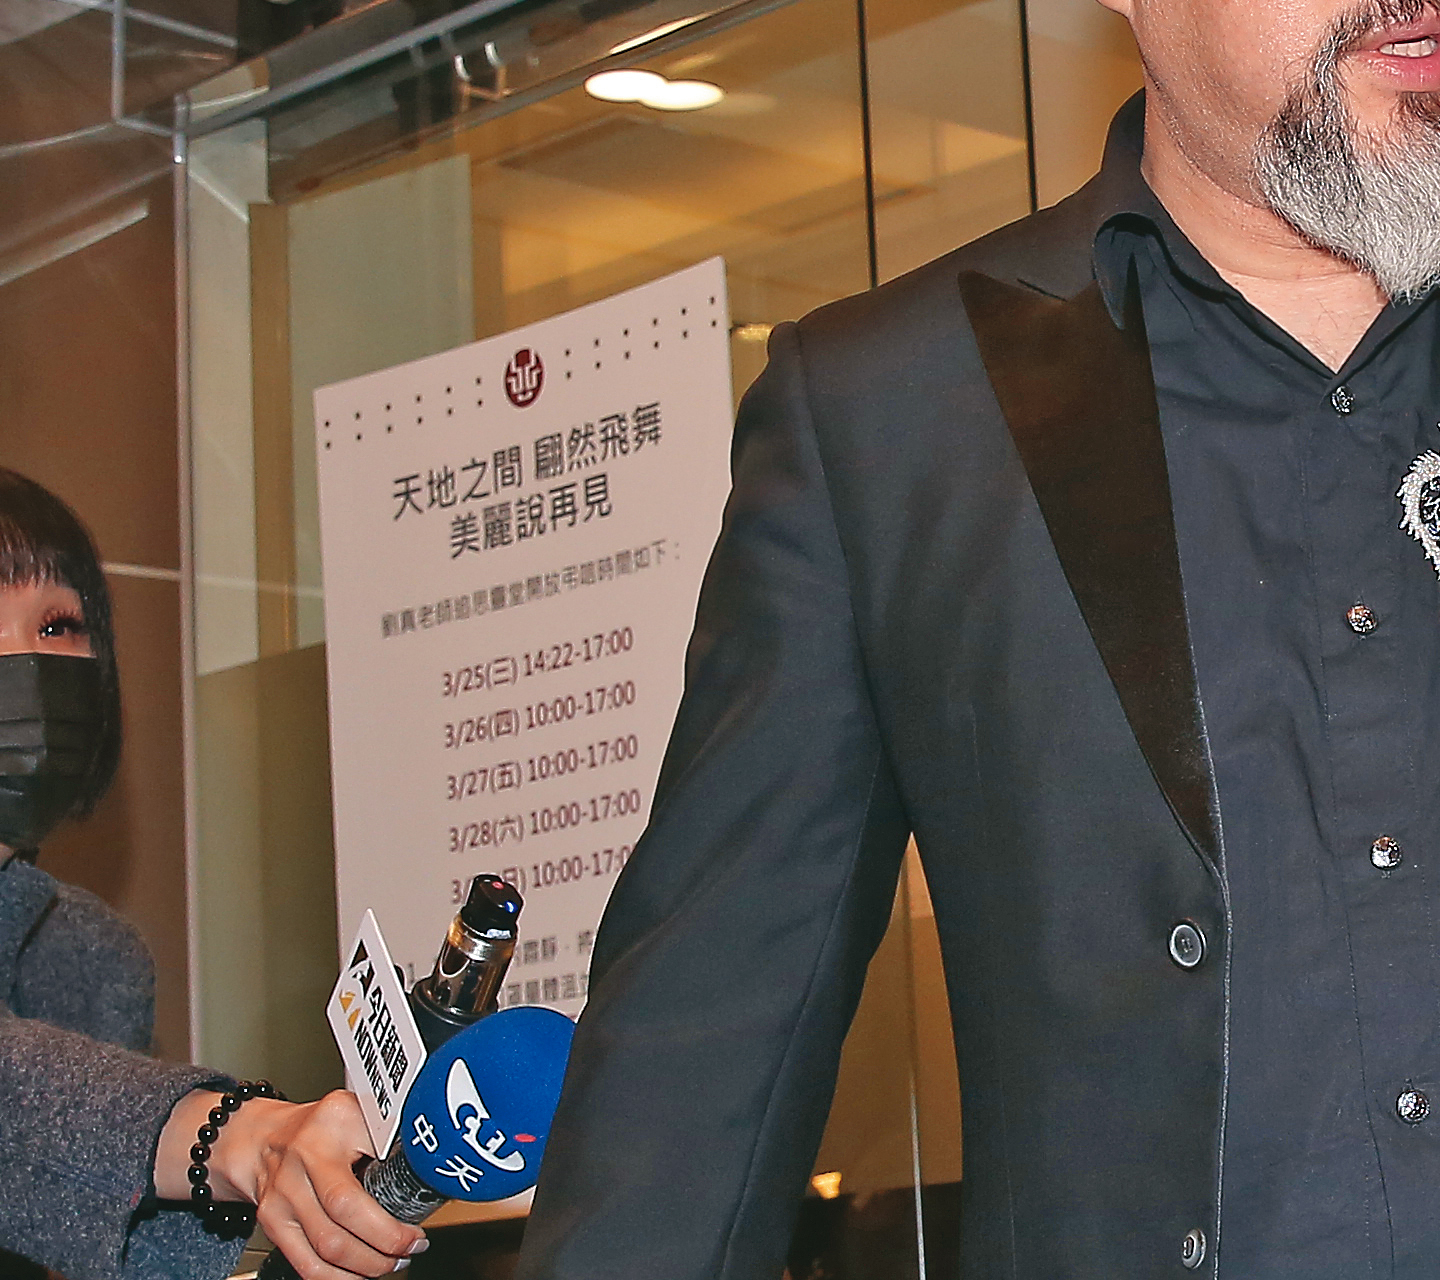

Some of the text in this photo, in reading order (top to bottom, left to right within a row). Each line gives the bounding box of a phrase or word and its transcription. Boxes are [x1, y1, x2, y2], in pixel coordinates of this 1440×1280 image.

[392, 400, 663, 521] 天地之間 翩然飛舞
[449, 472, 614, 561] 美麗說再見
[441, 626, 634, 698] 3/25(三) 14:22-17:00
[443, 679, 637, 750] 3/26(四) 10:00-17:00
[445, 734, 639, 802] 3/27(五) 10:00-17:00
[448, 787, 642, 855] 3/28(六) 10:00-17:00
[531, 845, 632, 889] 10:00-17:0
[367, 985, 411, 1095] 今日新聞
[411, 1112, 484, 1193] 中天
